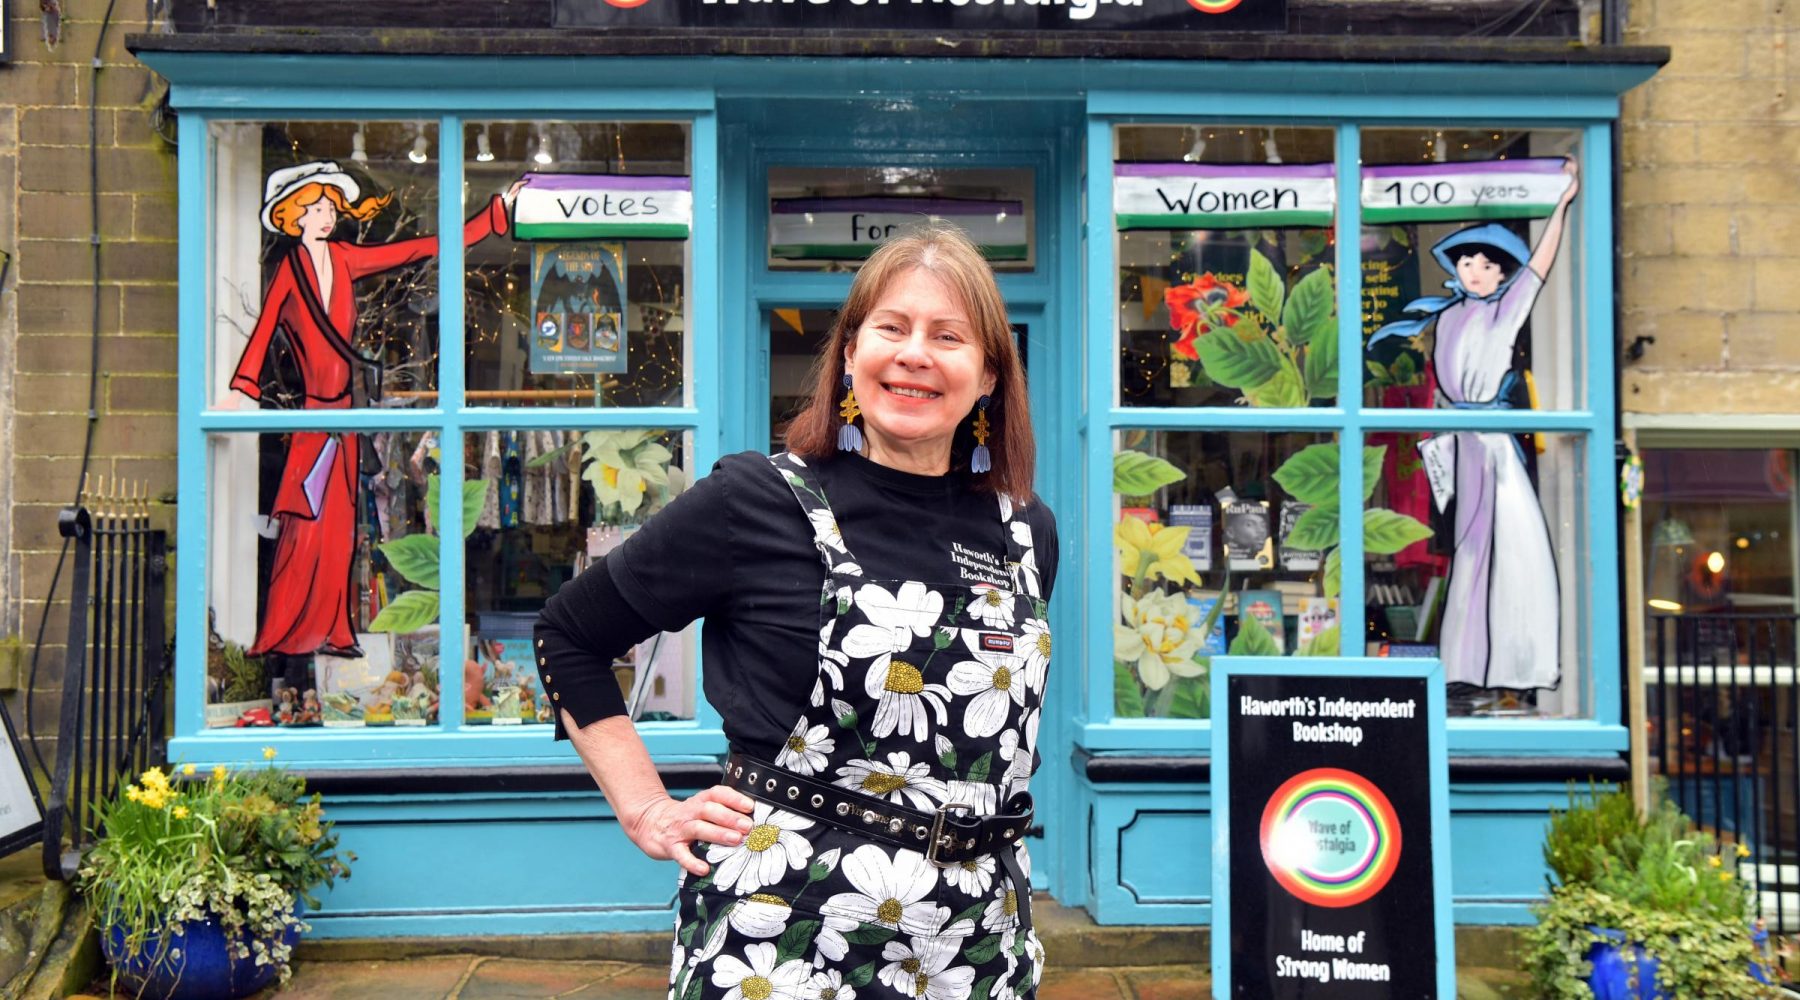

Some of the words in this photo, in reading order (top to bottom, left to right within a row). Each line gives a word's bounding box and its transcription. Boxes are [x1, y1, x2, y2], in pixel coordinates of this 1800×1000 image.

[1156, 182, 1299, 214] Women
[1384, 181, 1456, 206] 100
[1471, 183, 1530, 208] years
[851, 213, 897, 242] For
[1225, 503, 1267, 514] RuPaul
[952, 542, 1000, 566] Haworth's
[959, 566, 1010, 589] Bookshop
[1240, 695, 1316, 717] Haworth's
[1318, 696, 1416, 722] Independent
[1292, 721, 1363, 747] Bookshop
[1339, 819, 1352, 835] of
[1316, 837, 1357, 856] stalgia
[1300, 929, 1345, 953] Home
[1346, 930, 1366, 954] of
[1275, 955, 1331, 983] Strong
[1331, 957, 1391, 982] Women
